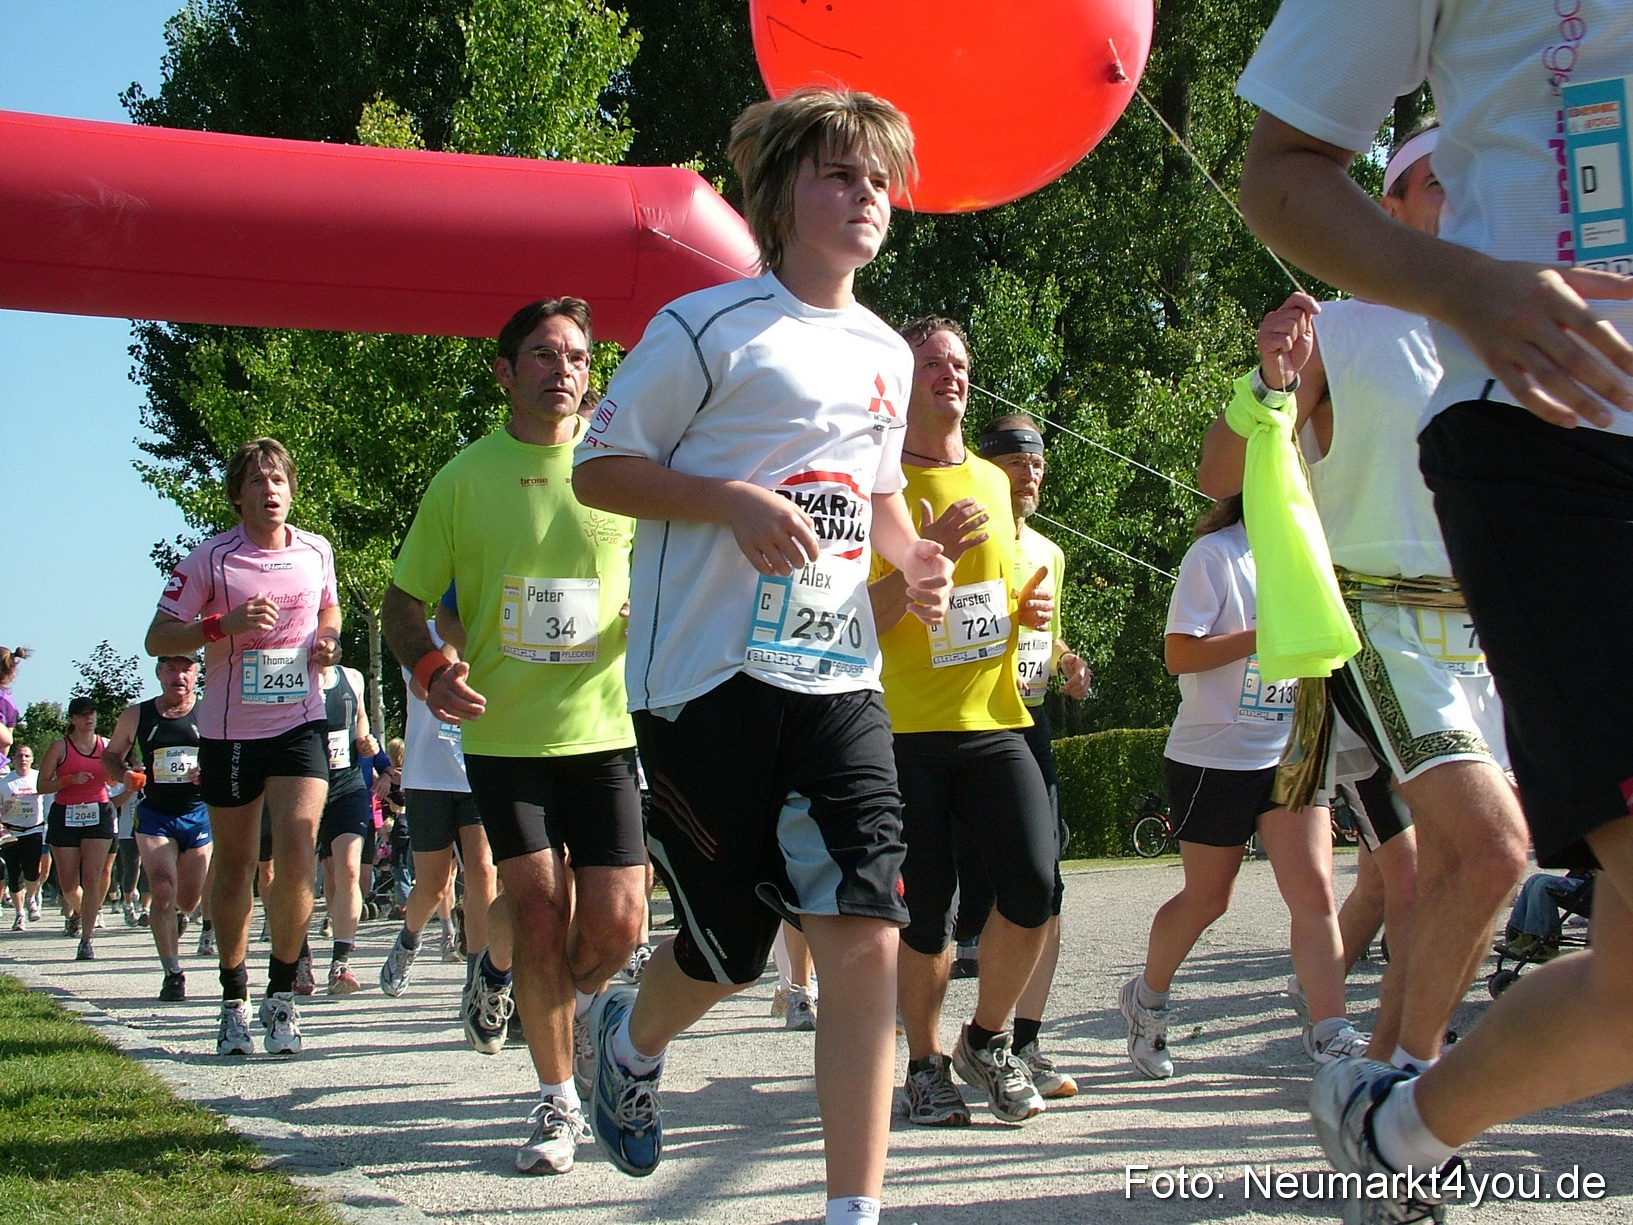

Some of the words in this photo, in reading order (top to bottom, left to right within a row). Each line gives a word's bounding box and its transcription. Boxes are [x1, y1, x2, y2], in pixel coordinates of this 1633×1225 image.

[1581, 165, 1597, 194] D
[520, 477, 548, 485] brose
[799, 564, 832, 590] Alex
[527, 585, 564, 602] Peter
[760, 593, 771, 611] C
[949, 592, 991, 610] Karsten
[504, 608, 511, 620] D
[545, 616, 577, 640] 34
[791, 607, 862, 649] 2570
[962, 615, 1000, 640] 721
[1018, 642, 1030, 651] urt
[262, 654, 294, 665] Thomas
[747, 650, 803, 666] BOCK
[245, 670, 251, 679] C
[1018, 661, 1043, 679] 974
[263, 672, 305, 690] 2434
[1246, 678, 1253, 688] C
[231, 741, 242, 764] CLUB
[170, 762, 192, 773] 847
[230, 763, 240, 779] THE
[74, 811, 97, 820] 2048
